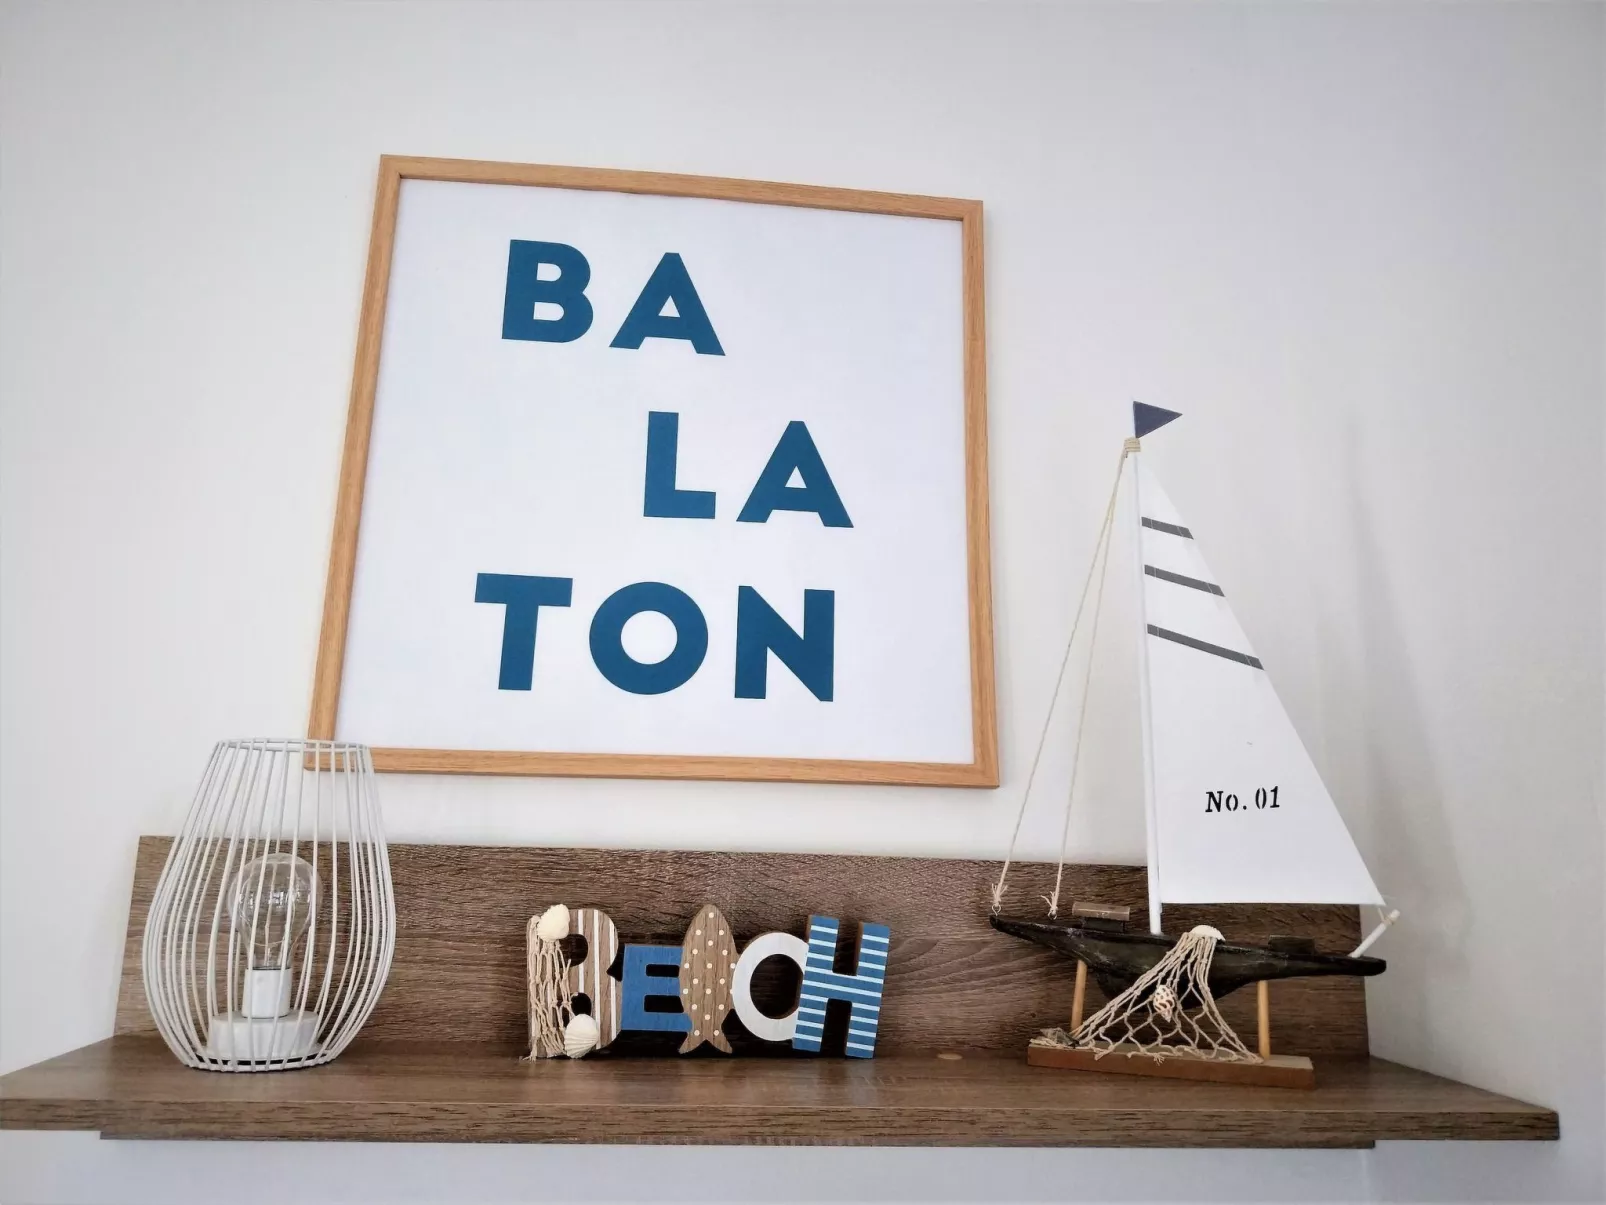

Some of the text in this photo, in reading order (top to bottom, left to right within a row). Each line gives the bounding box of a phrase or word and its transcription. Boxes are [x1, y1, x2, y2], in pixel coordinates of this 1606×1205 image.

[502, 239, 726, 356] BA
[644, 411, 853, 528] LA
[475, 573, 836, 702] TON
[1205, 785, 1280, 813] No. 01
